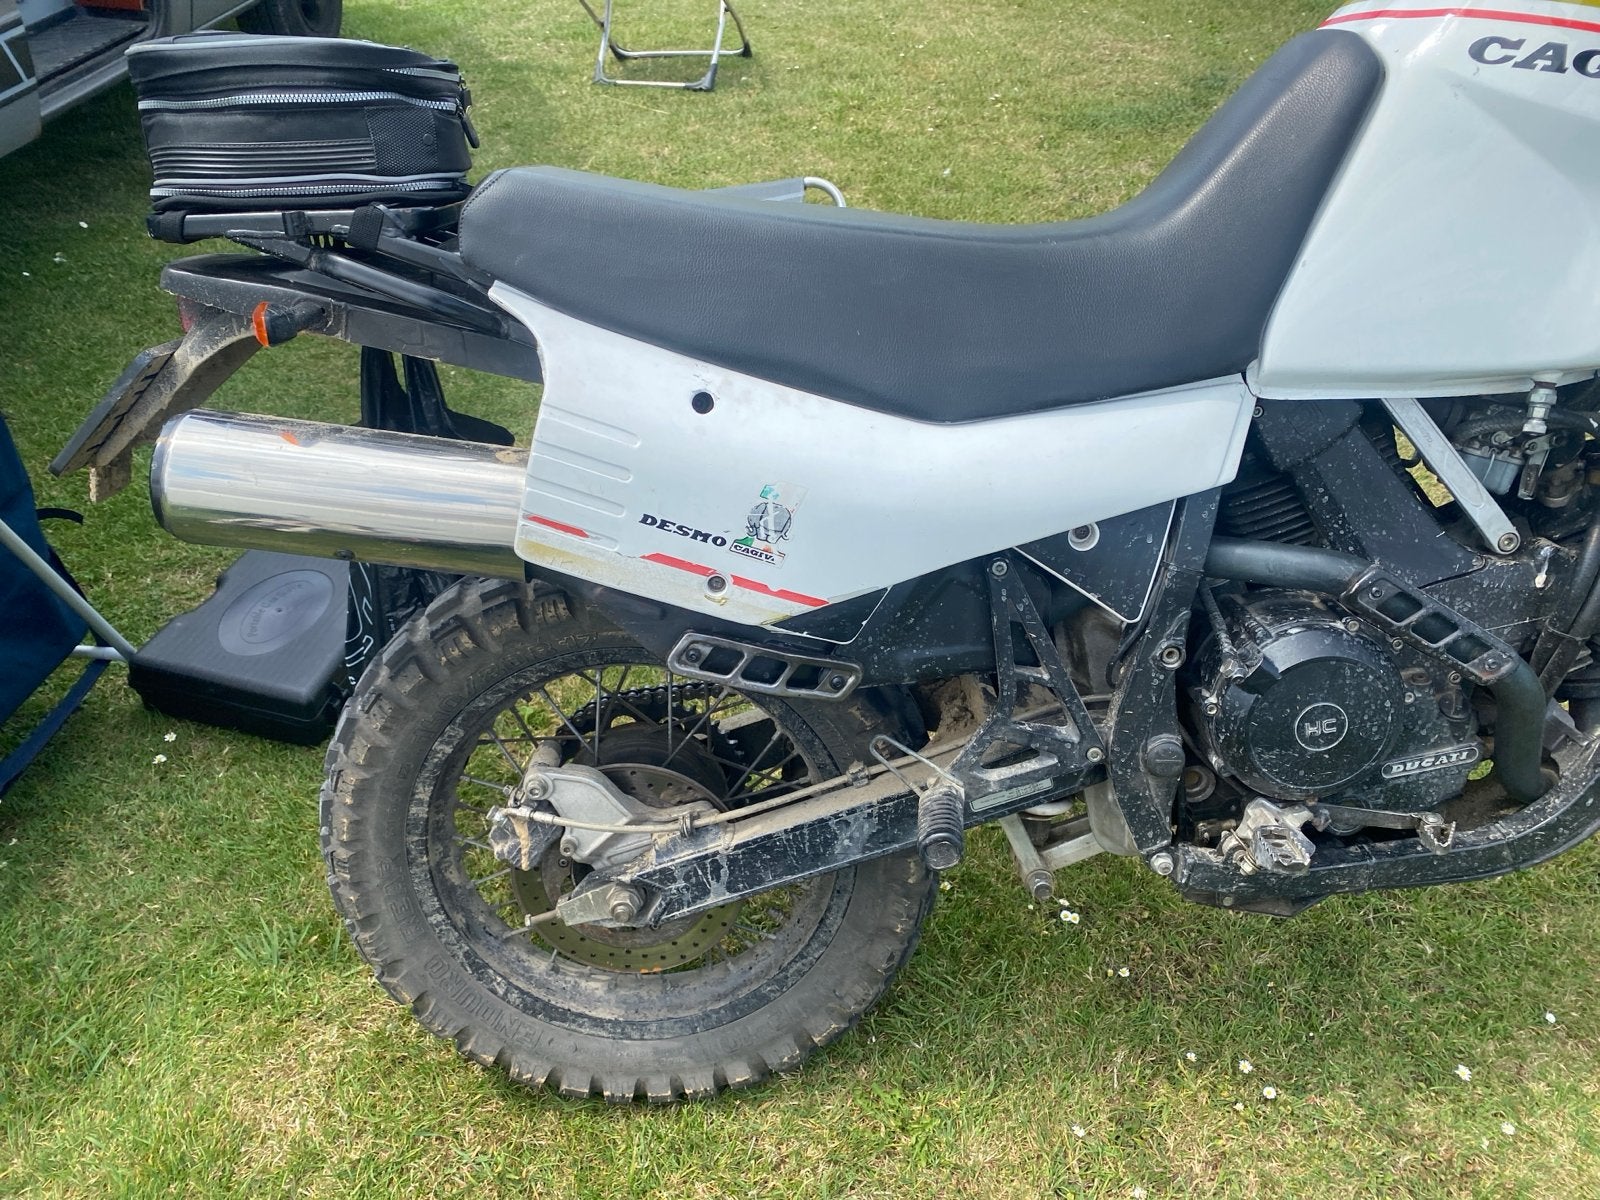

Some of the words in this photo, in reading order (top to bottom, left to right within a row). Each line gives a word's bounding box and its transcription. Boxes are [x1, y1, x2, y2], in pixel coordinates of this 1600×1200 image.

[638, 513, 727, 547] DESMO
[733, 544, 776, 562] CAGIV
[1304, 718, 1337, 737] HC
[1390, 751, 1469, 773] DUCATI
[424, 955, 541, 1048] ENDURO
